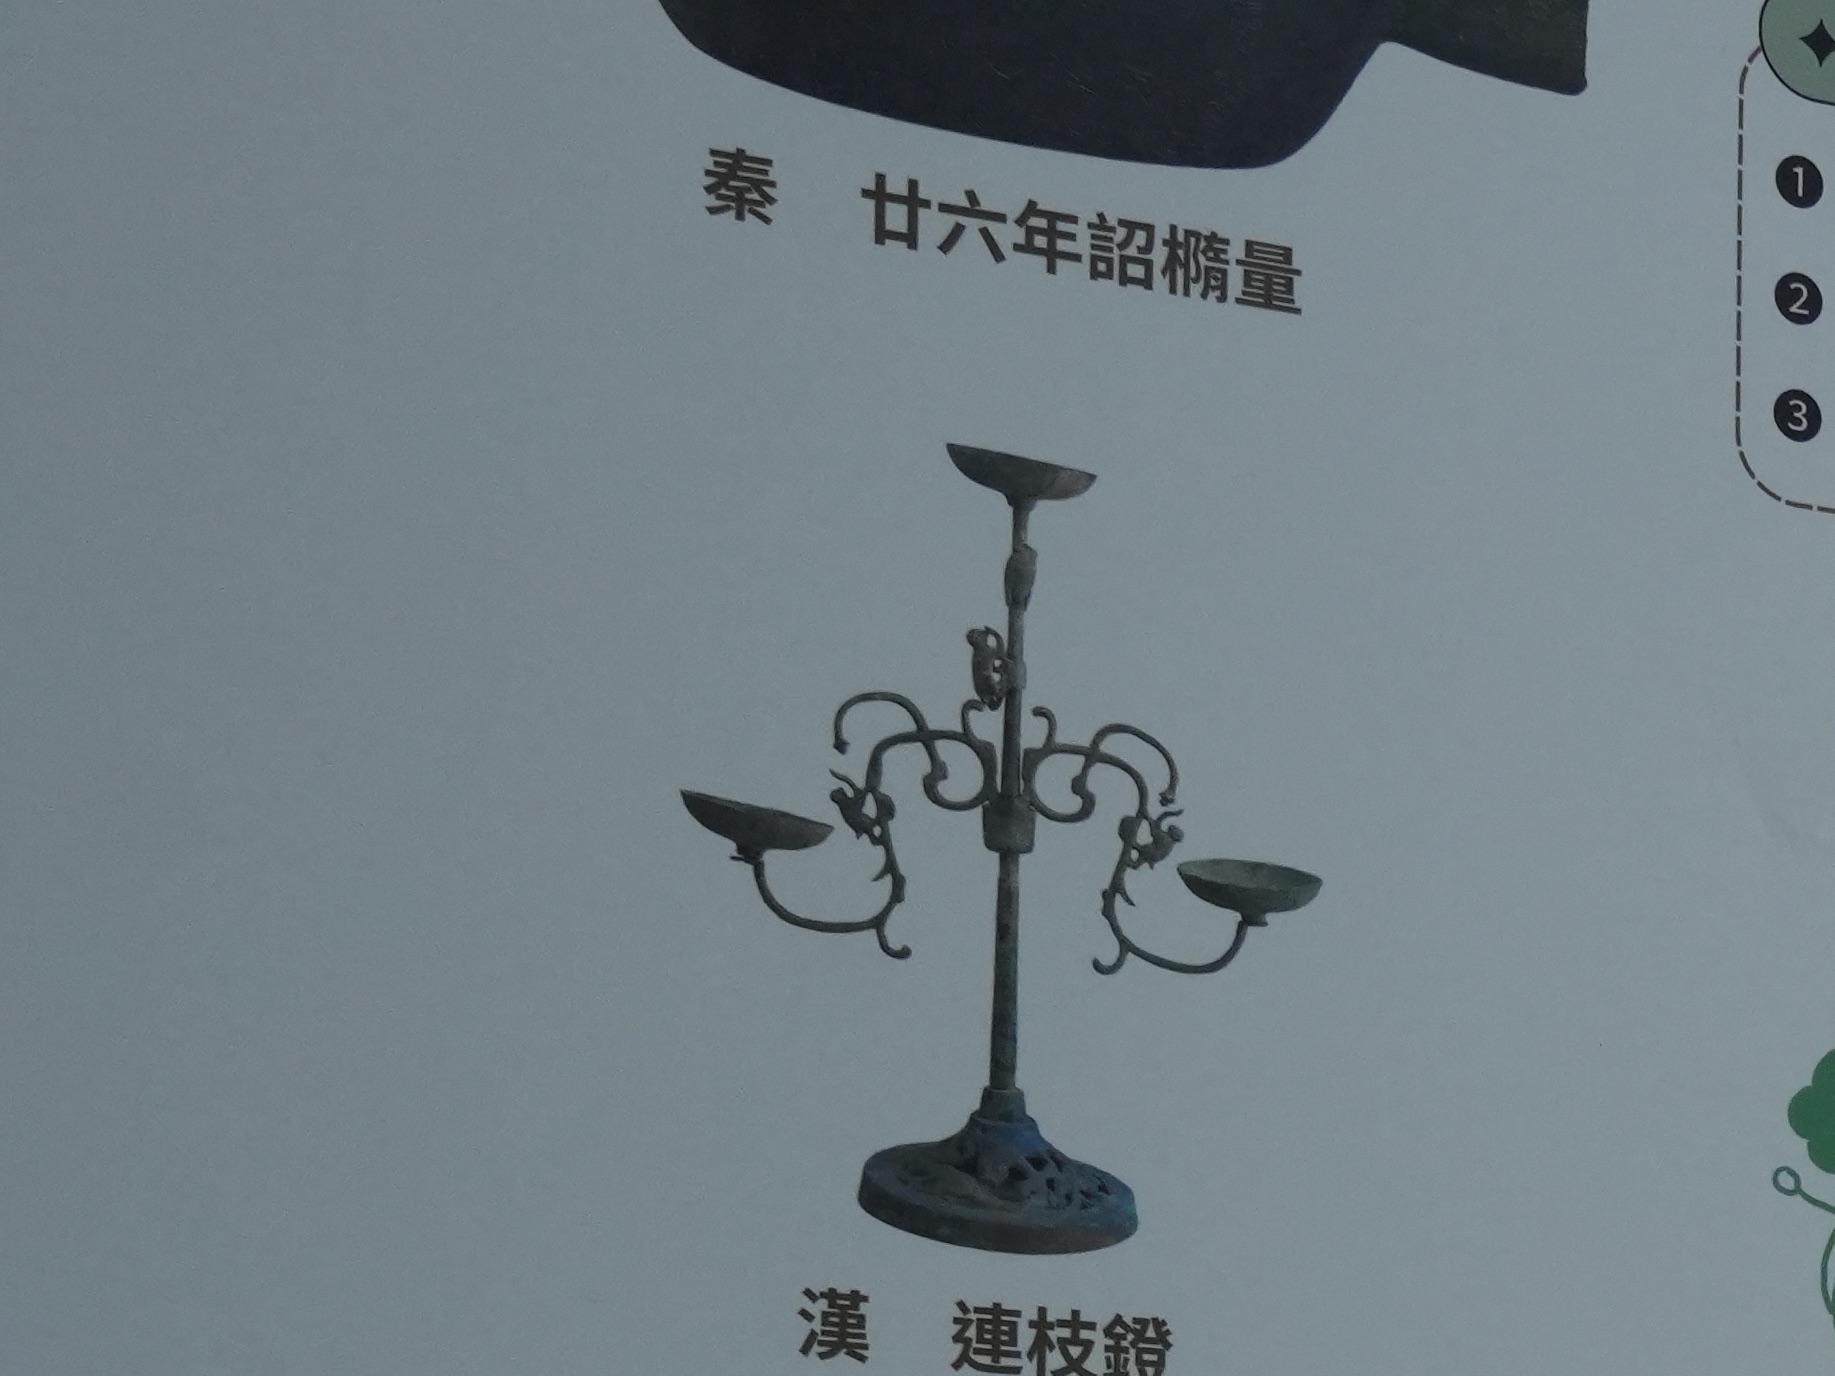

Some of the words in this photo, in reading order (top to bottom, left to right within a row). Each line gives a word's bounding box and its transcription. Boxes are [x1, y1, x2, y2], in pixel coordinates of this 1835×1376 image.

[703, 147, 778, 225] 秦
[860, 171, 1302, 315] 廿六年詔橢量
[797, 1287, 869, 1364] 漢
